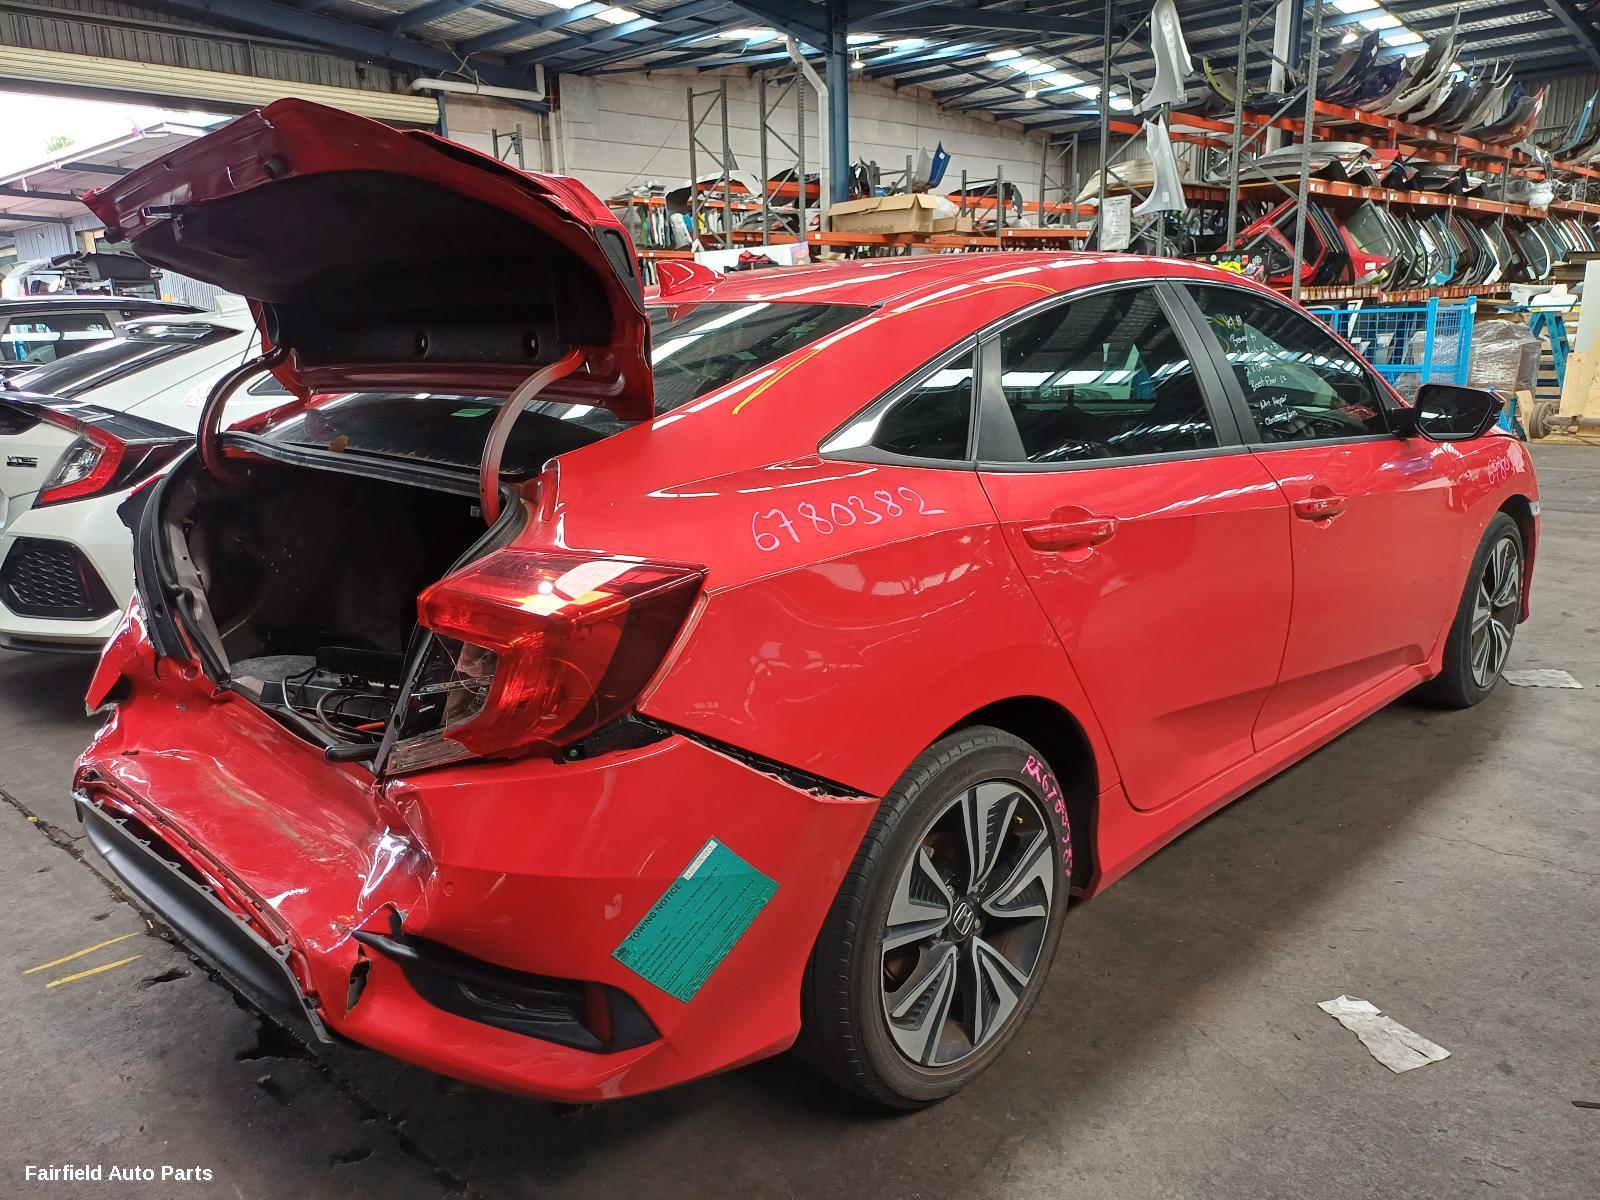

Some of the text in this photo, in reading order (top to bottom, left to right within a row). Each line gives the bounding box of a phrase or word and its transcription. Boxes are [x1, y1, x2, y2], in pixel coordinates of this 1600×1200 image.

[751, 486, 947, 552] 6780382
[629, 882, 682, 941] TOWING NOTICE
